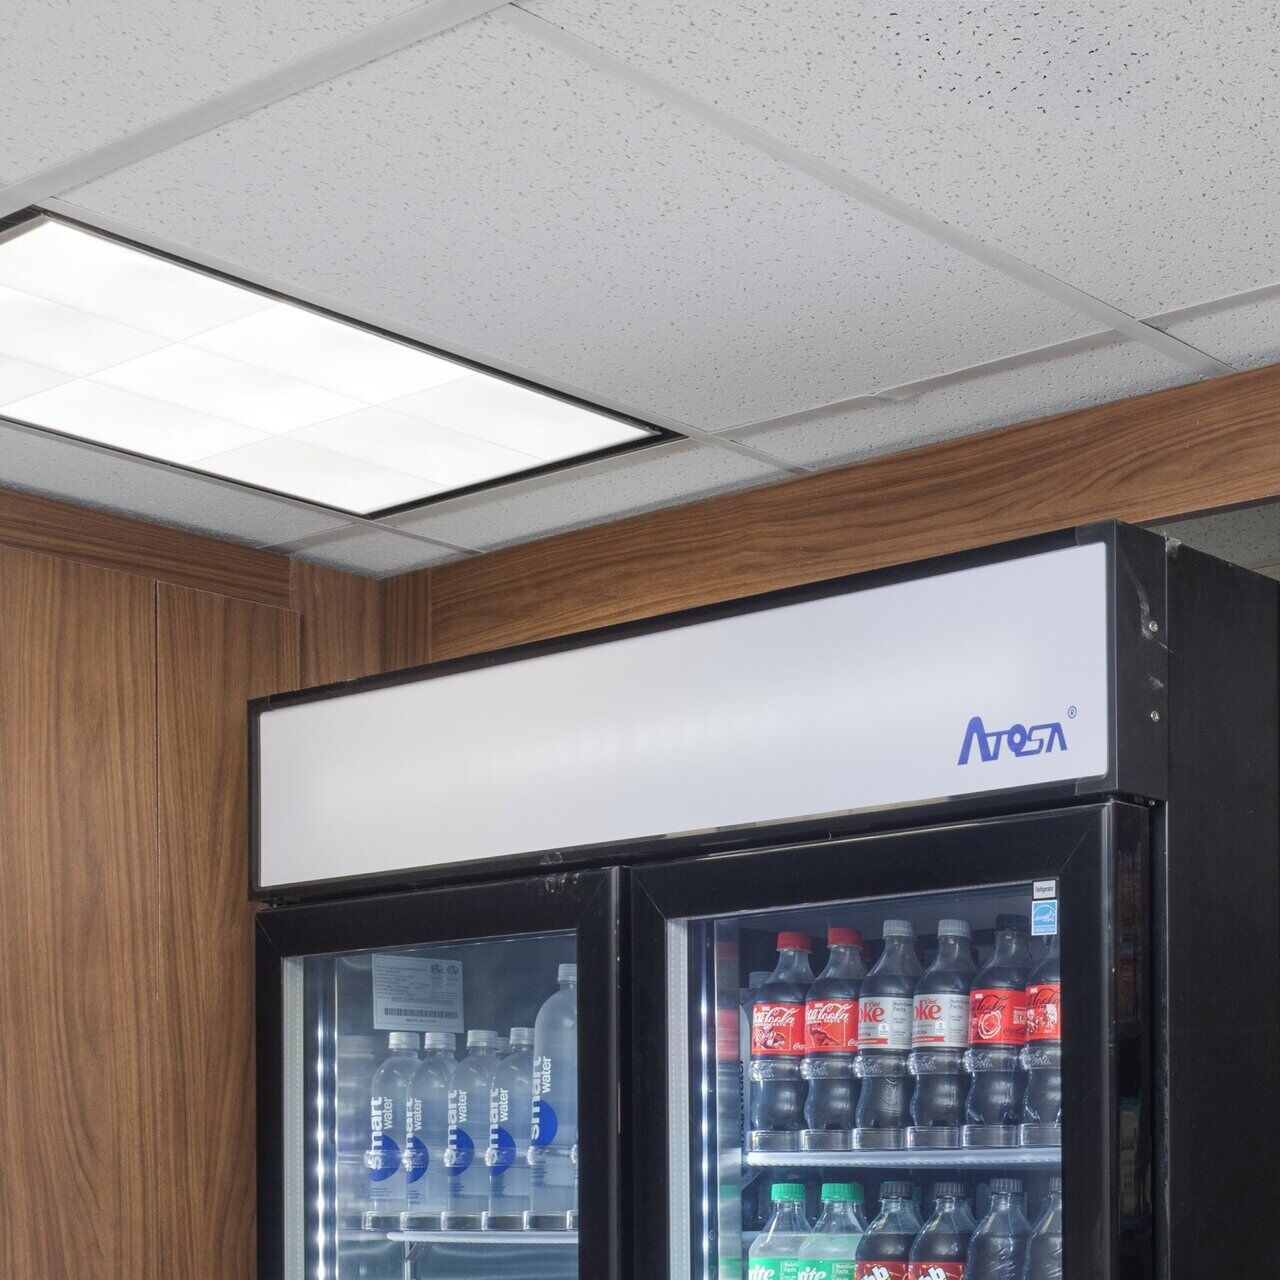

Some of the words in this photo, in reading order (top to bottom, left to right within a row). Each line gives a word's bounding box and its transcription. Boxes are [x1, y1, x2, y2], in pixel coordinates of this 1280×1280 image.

[542, 1056, 551, 1094] water
[382, 1097, 393, 1130] water
[458, 1090, 467, 1123] water
[500, 1088, 509, 1122] water
[531, 1056, 541, 1140] smart
